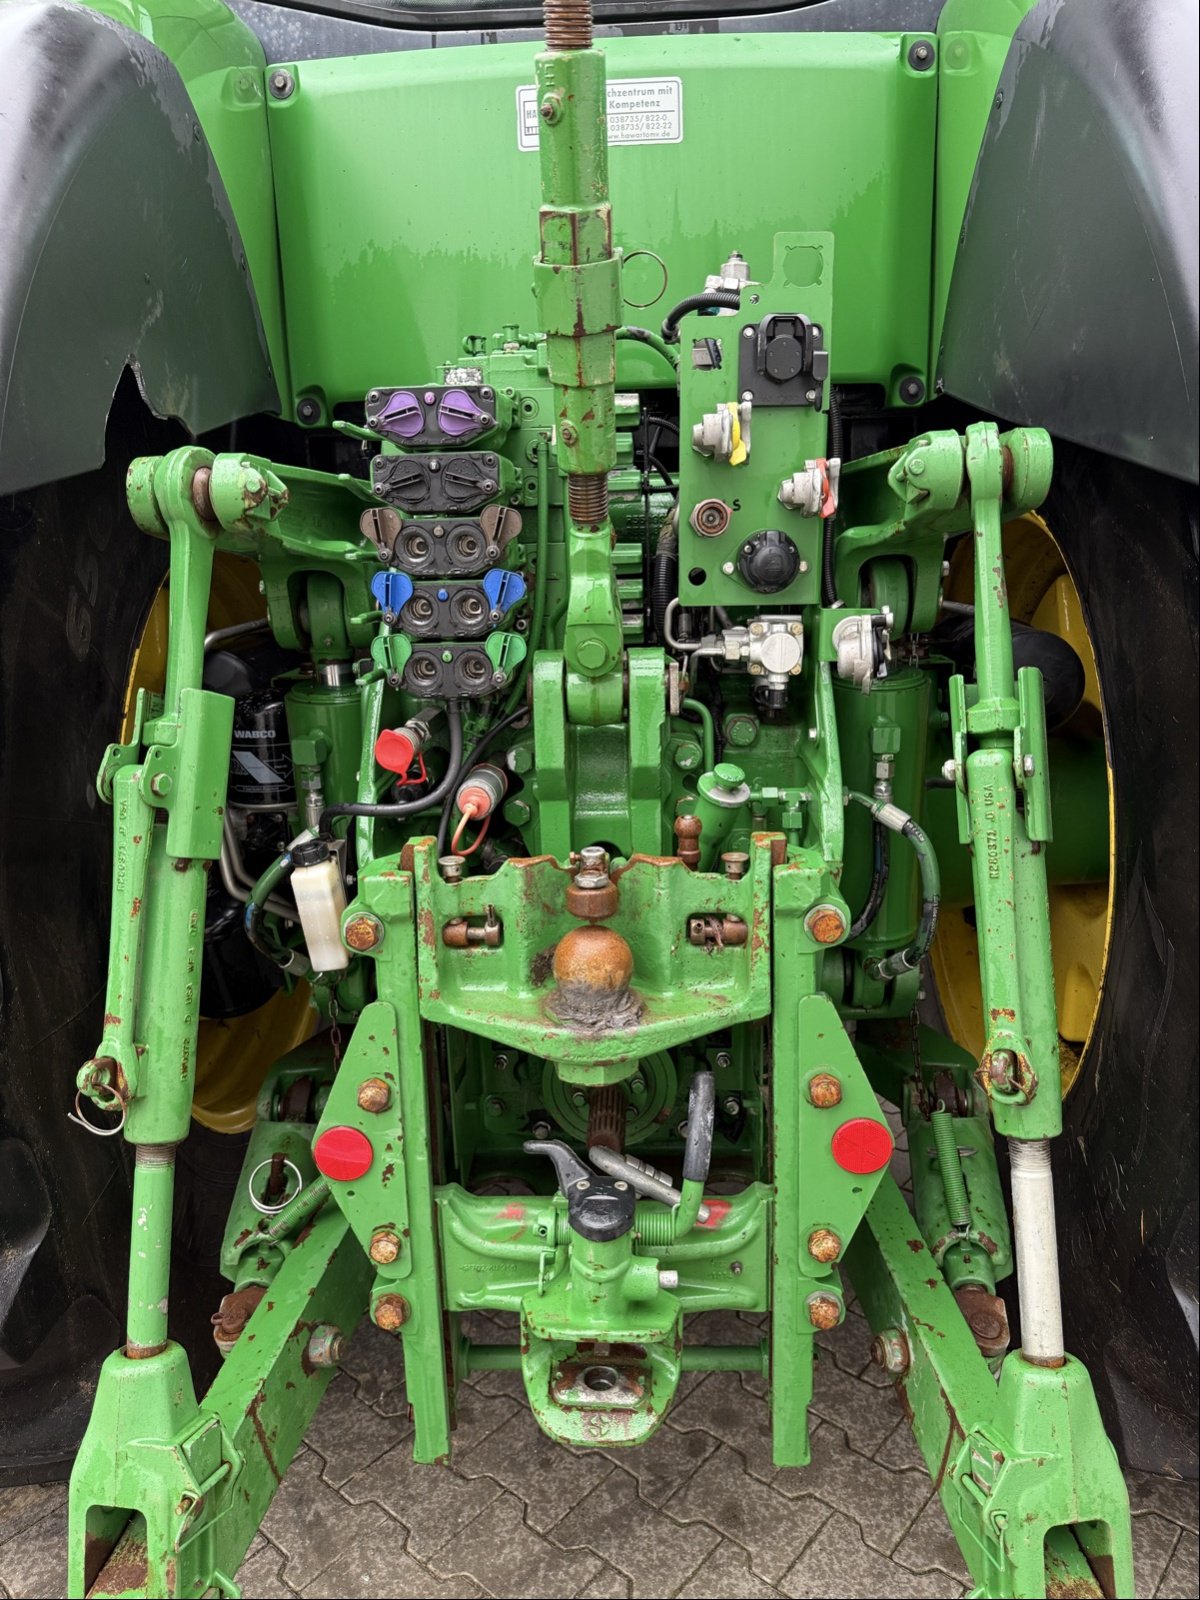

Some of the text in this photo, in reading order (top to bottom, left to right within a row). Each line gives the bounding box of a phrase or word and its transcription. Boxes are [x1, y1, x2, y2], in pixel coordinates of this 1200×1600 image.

[658, 85, 673, 95] mit
[608, 99, 661, 110] Kompetenz
[233, 729, 276, 739] WABCO
[983, 784, 994, 807] USA
